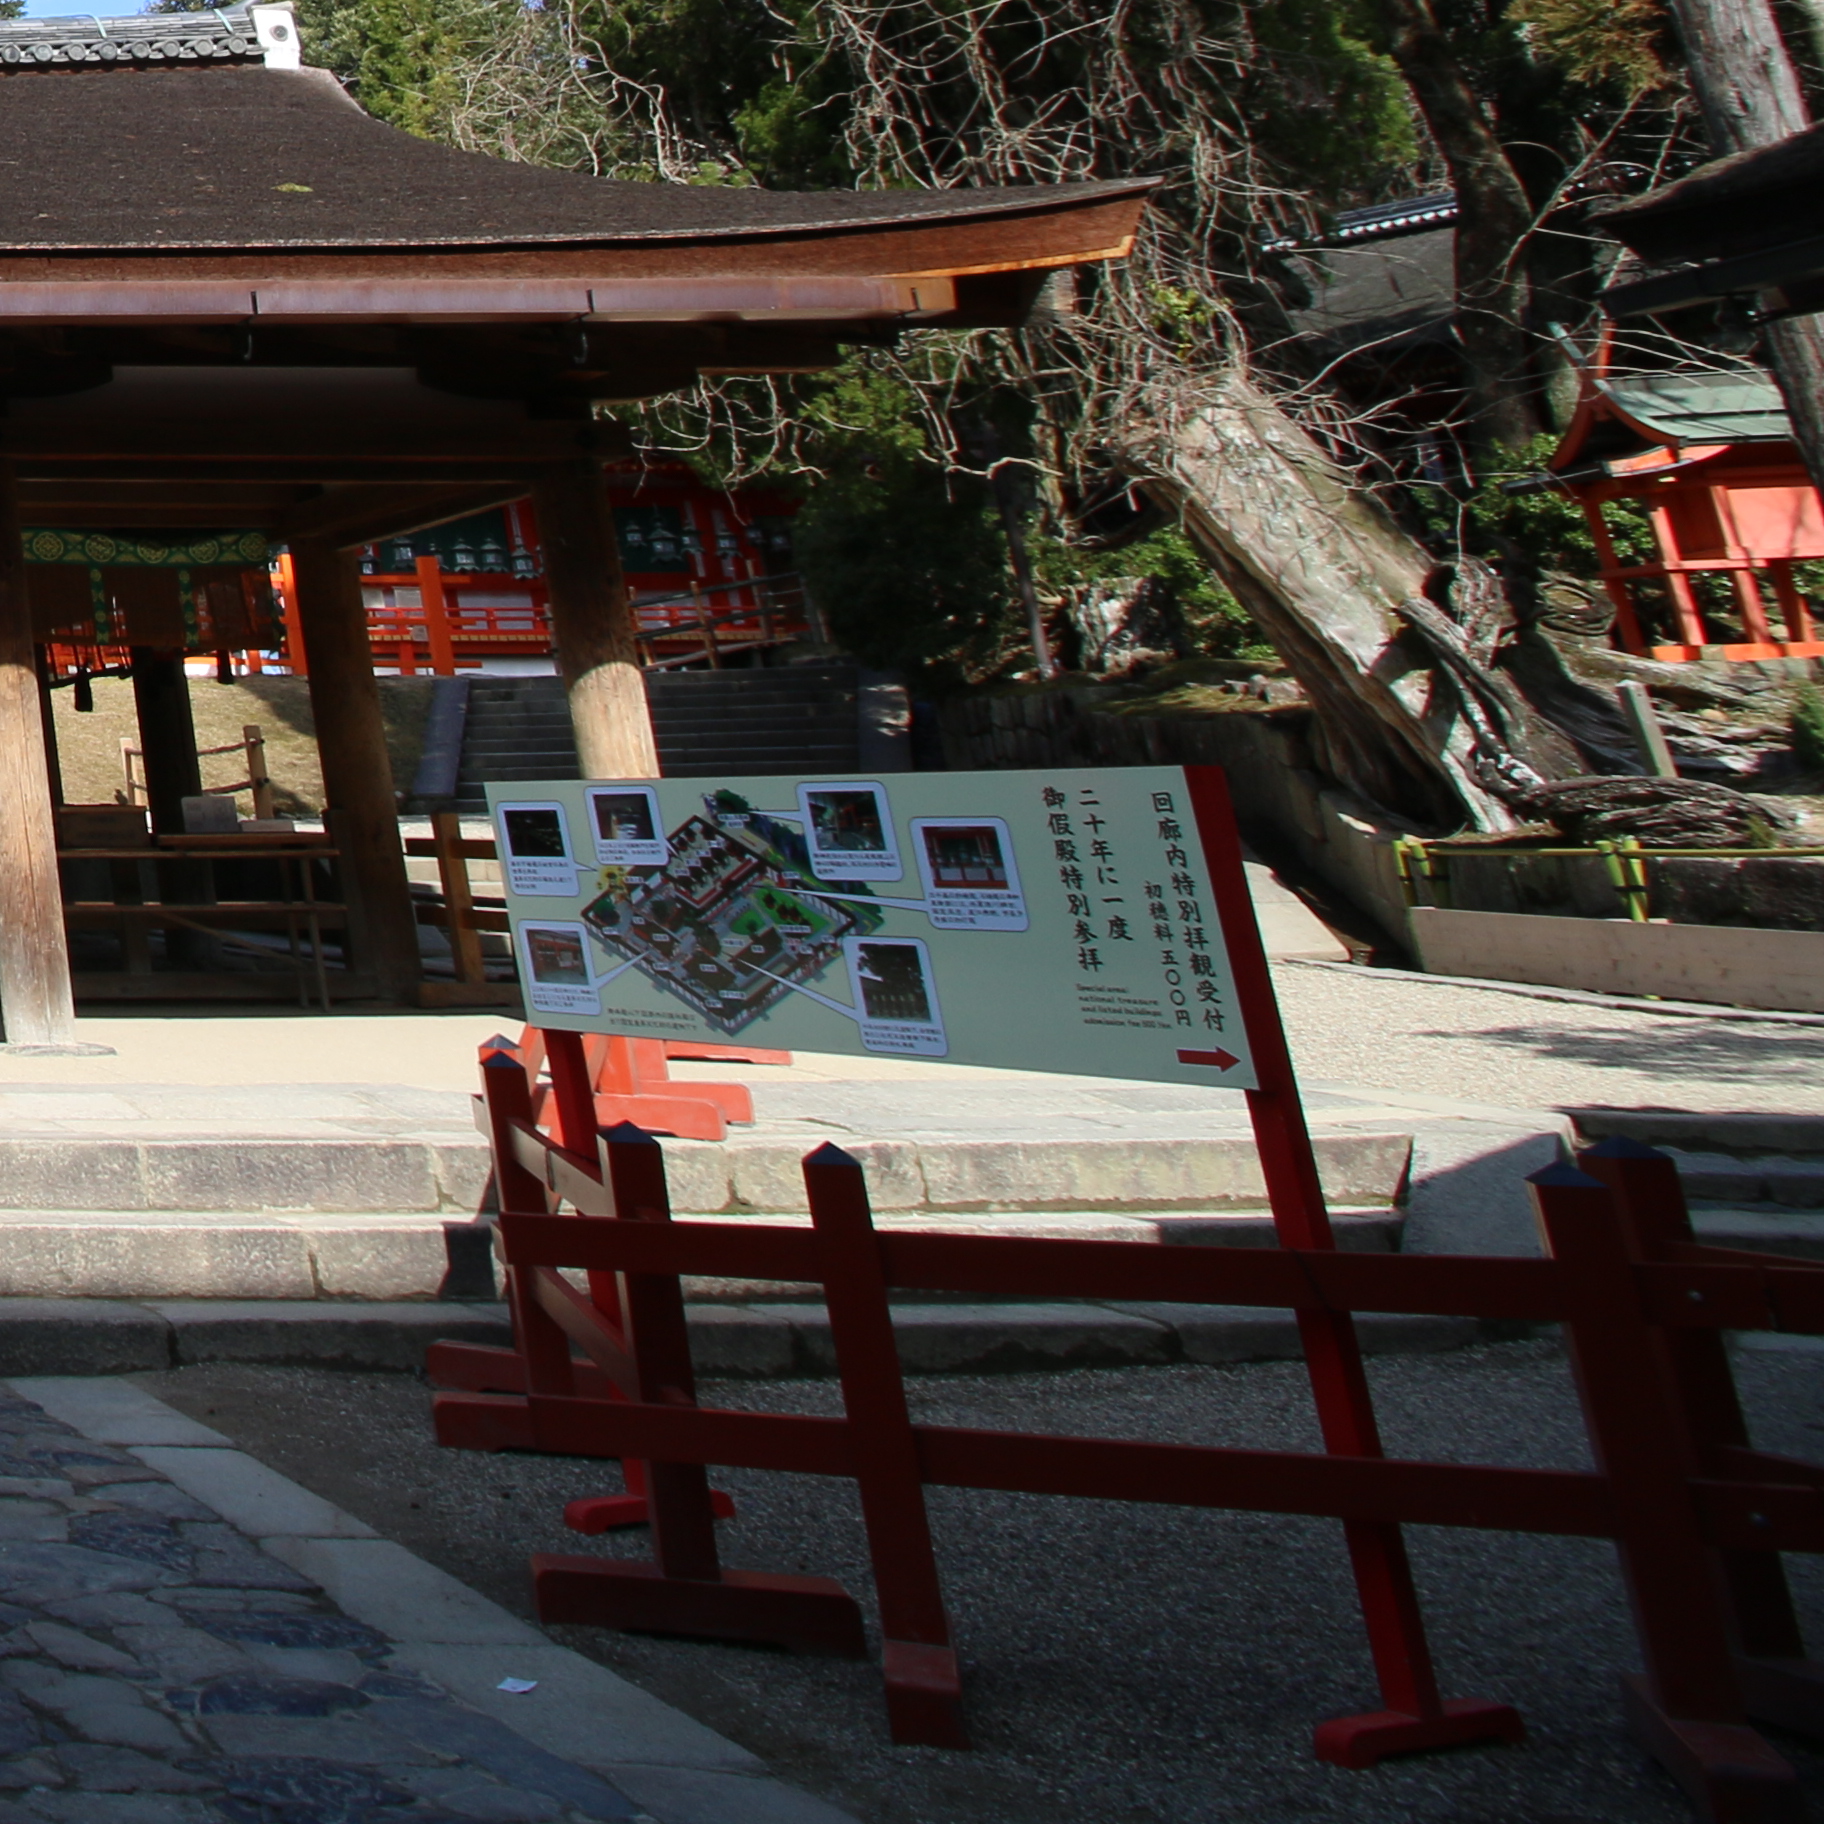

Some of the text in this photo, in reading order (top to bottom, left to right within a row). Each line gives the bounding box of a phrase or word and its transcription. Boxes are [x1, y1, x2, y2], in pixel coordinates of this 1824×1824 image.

[1042, 786, 1104, 973] 御假殿特別参拝
[1079, 789, 1133, 941] 二十年に一度
[1151, 791, 1225, 1033] 回廊内特別拝観受付
